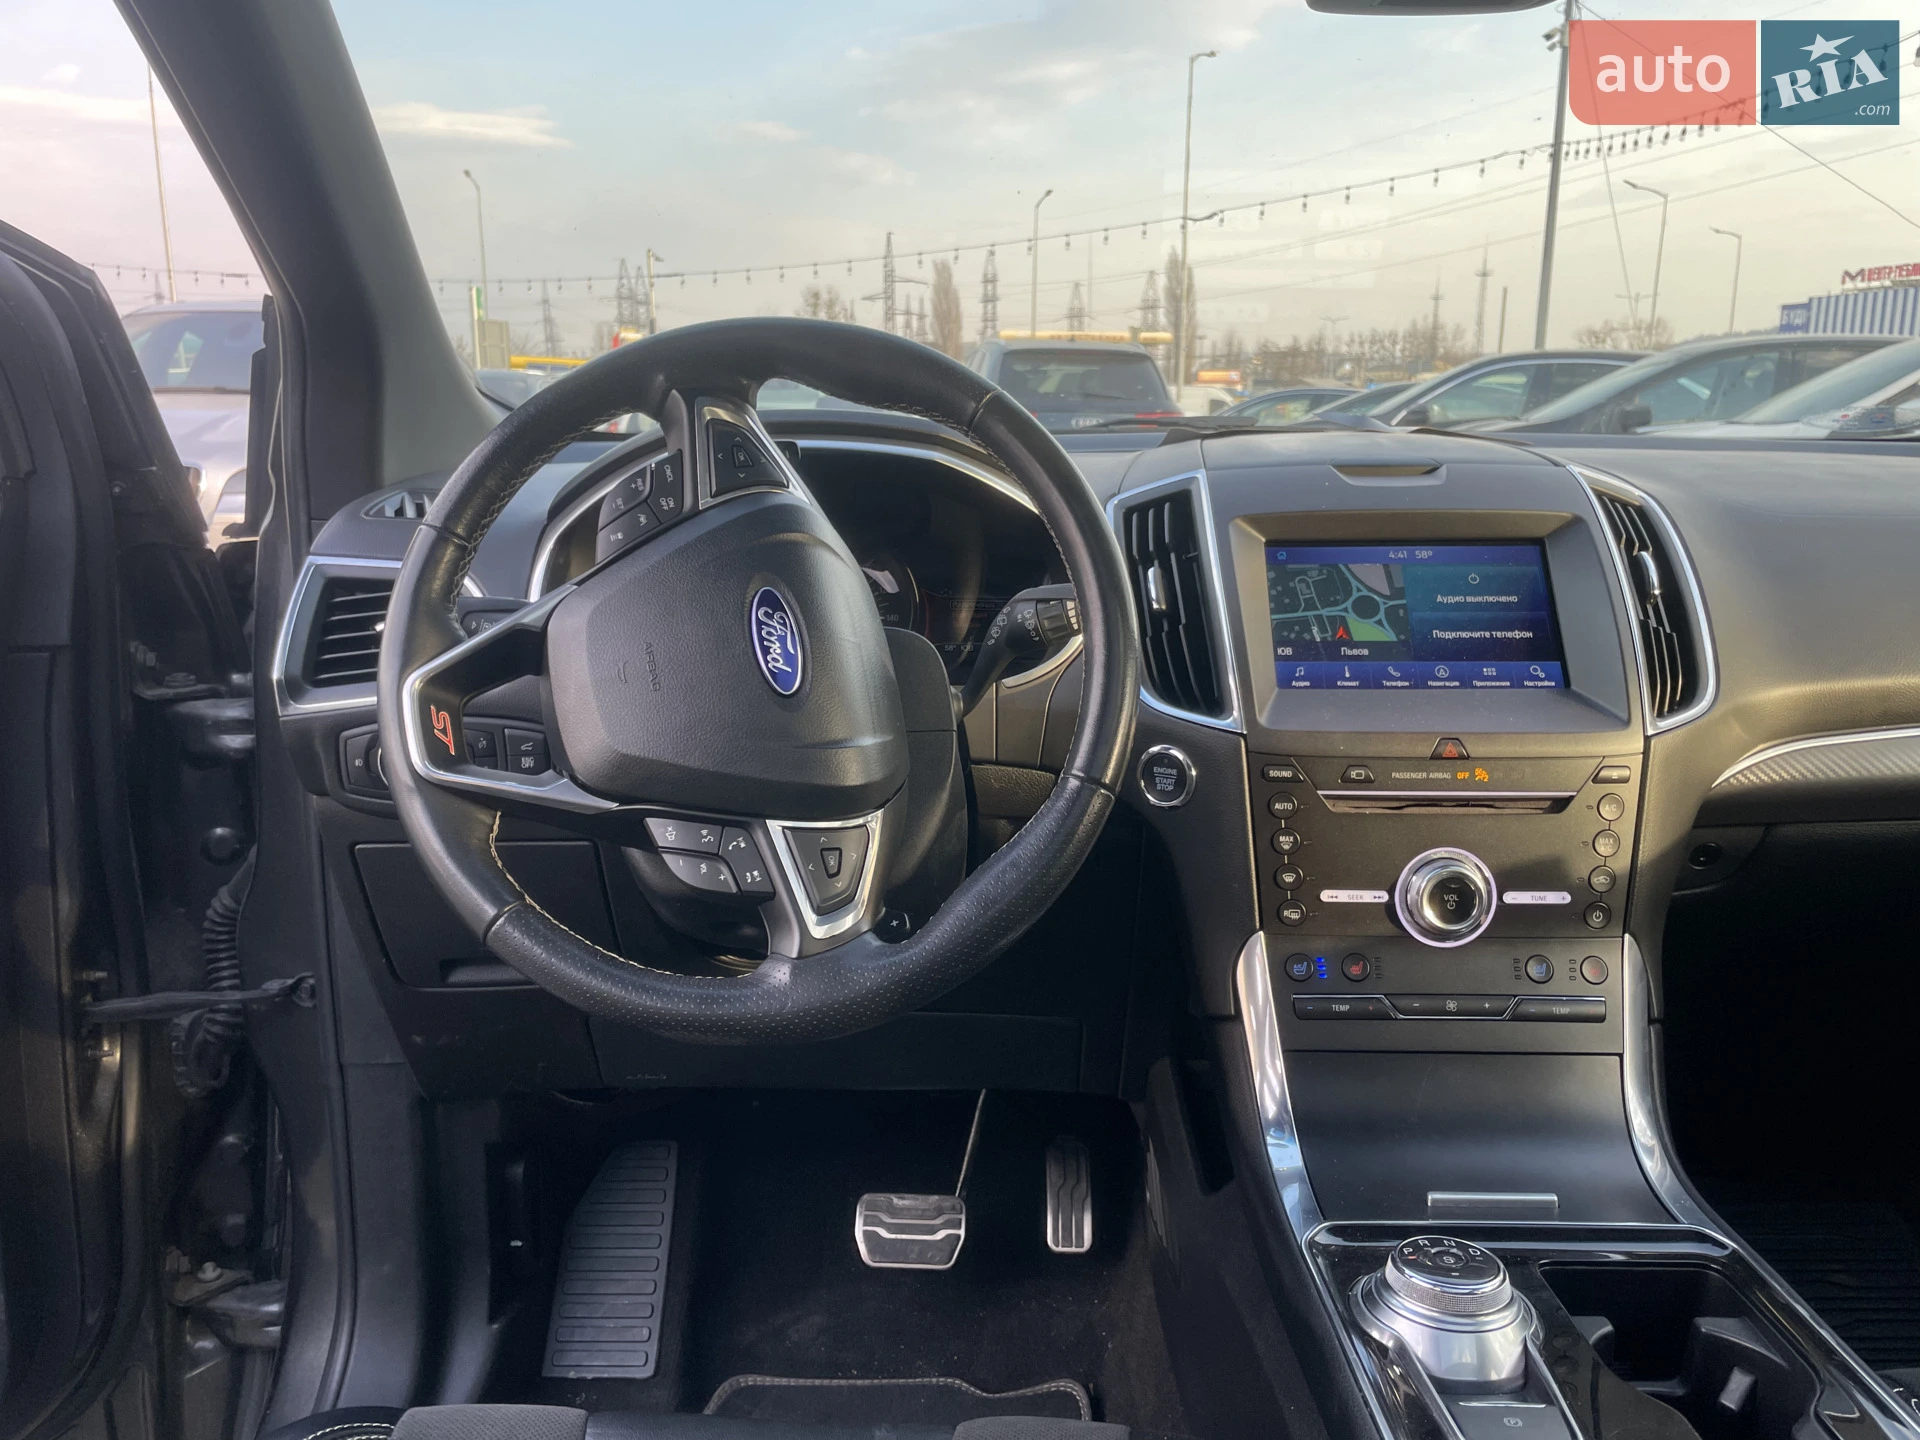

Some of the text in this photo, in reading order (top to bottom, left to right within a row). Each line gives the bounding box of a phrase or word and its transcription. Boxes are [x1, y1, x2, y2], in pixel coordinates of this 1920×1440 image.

[1389, 550, 1407, 559] 4:41
[1437, 594, 1518, 603] Аудио выключено
[886, 614, 899, 622] 140
[1433, 630, 1533, 639] Подключите телефон
[758, 606, 794, 673] Ford
[1277, 647, 1292, 656] ЮВ
[643, 641, 661, 693] AIRBAG
[430, 704, 455, 756] ST
[1153, 766, 1177, 775] ENGINE
[1269, 770, 1293, 778] SOUND
[1456, 772, 1470, 780] OFF
[1155, 777, 1175, 785] START
[1156, 783, 1174, 791] STOP
[1274, 802, 1293, 810] AUTO
[1604, 804, 1617, 812] A/C
[1332, 1004, 1350, 1012] TEMP
[1552, 1007, 1570, 1015] TEMP
[1468, 1248, 1481, 1256] D
